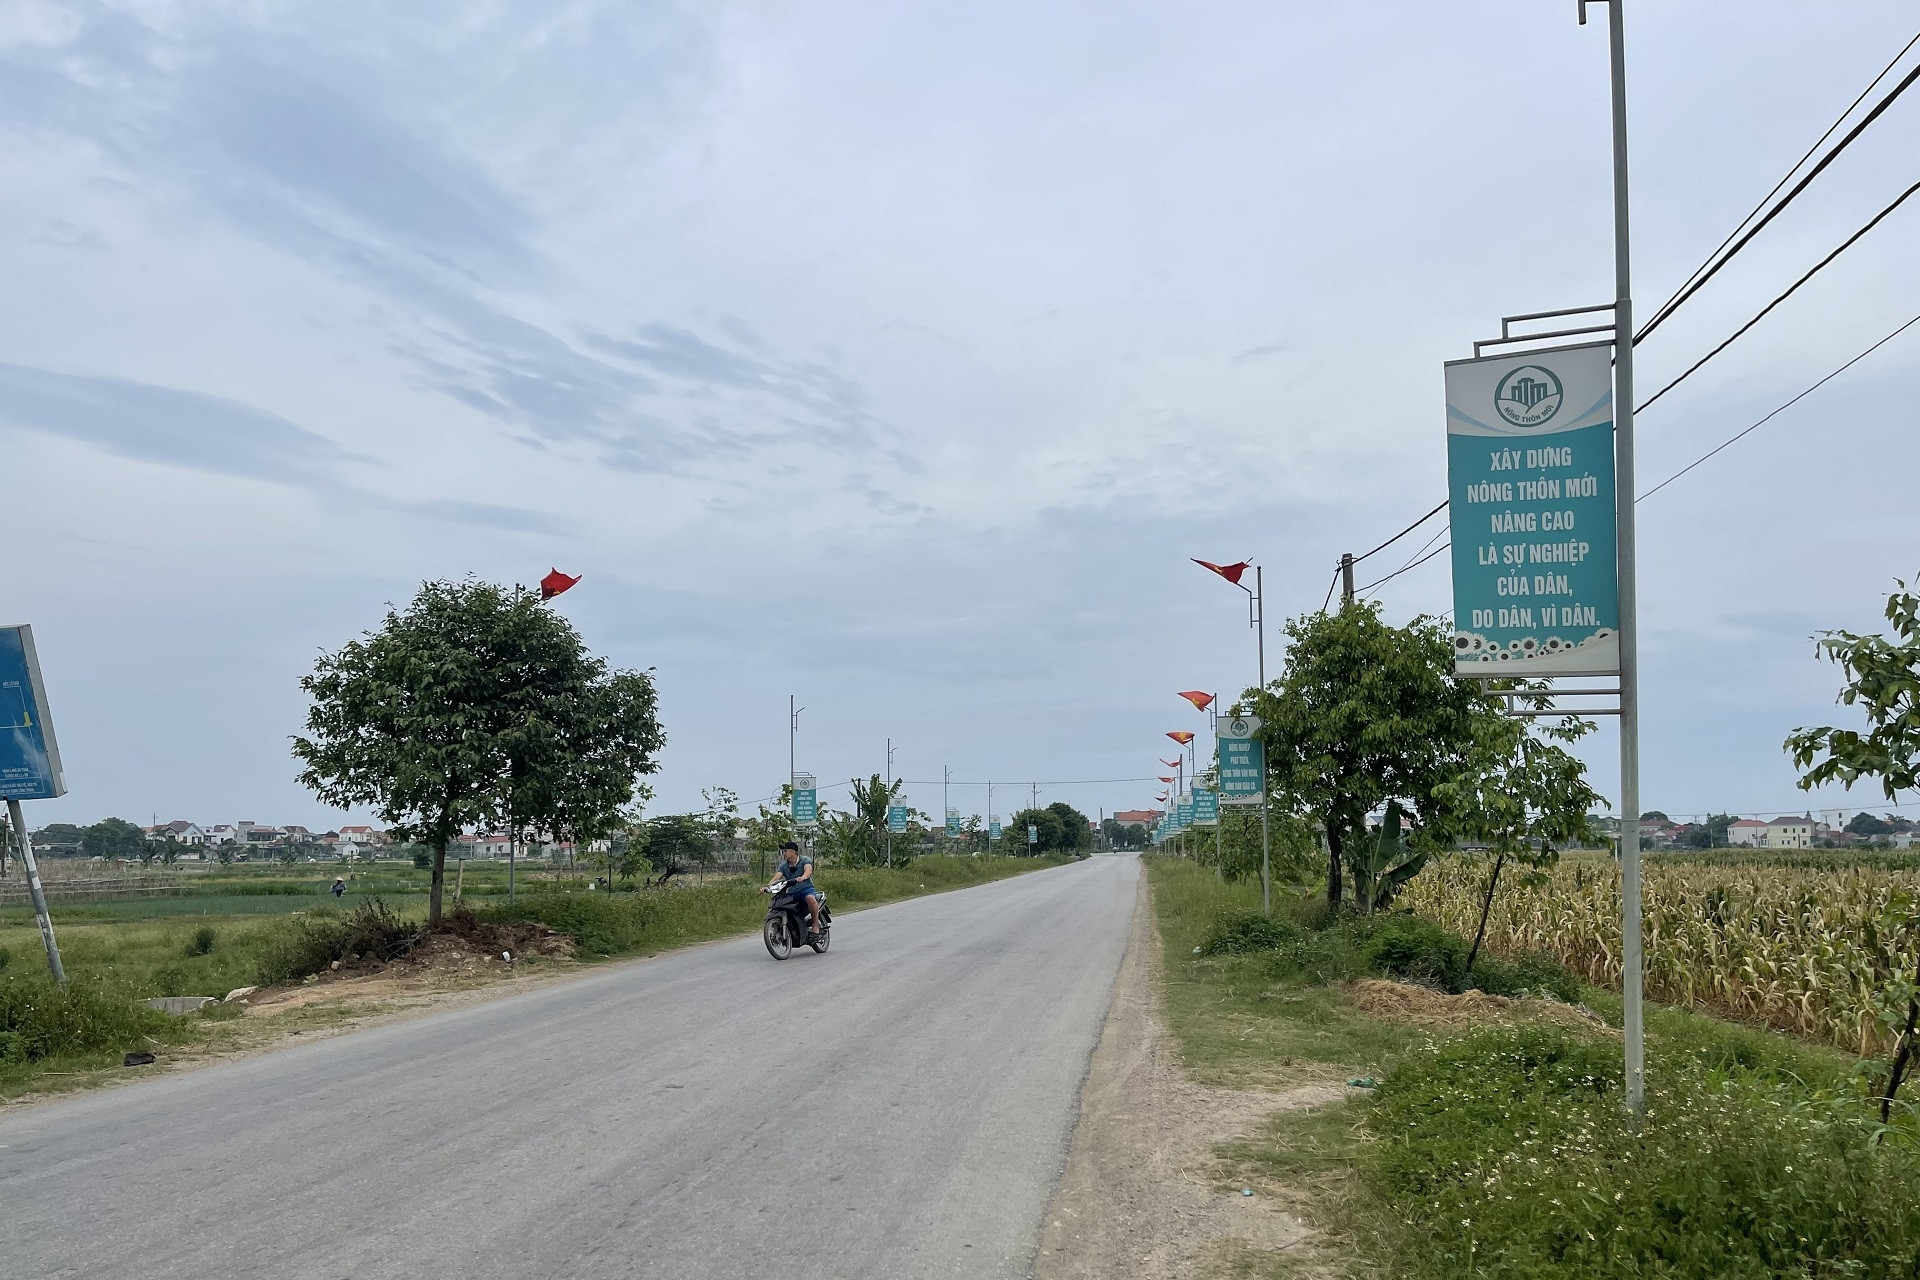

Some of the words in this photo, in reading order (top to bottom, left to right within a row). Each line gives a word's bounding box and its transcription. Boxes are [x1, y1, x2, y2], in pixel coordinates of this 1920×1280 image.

[1503, 406, 1521, 421] NÔNG
[1521, 414, 1541, 422] THÔN
[1490, 448, 1521, 471] XÂY
[1527, 446, 1572, 471] DỰNG
[1467, 480, 1512, 503] NÔNG
[1517, 477, 1560, 500] THÔN
[1565, 472, 1597, 498] MỚI
[1491, 510, 1536, 533] NÂNG
[1542, 511, 1574, 531] CAO
[1479, 542, 1498, 565] LÀ
[1503, 543, 1526, 568] SỰ
[1530, 539, 1589, 566] NGHIỆP
[1497, 569, 1530, 596] CỦA
[1535, 571, 1573, 596] DÂN,
[1472, 609, 1493, 629] DO
[1499, 605, 1537, 629] DÂN,
[1542, 603, 1557, 627] VÌ
[1562, 603, 1600, 626] DÂN.
